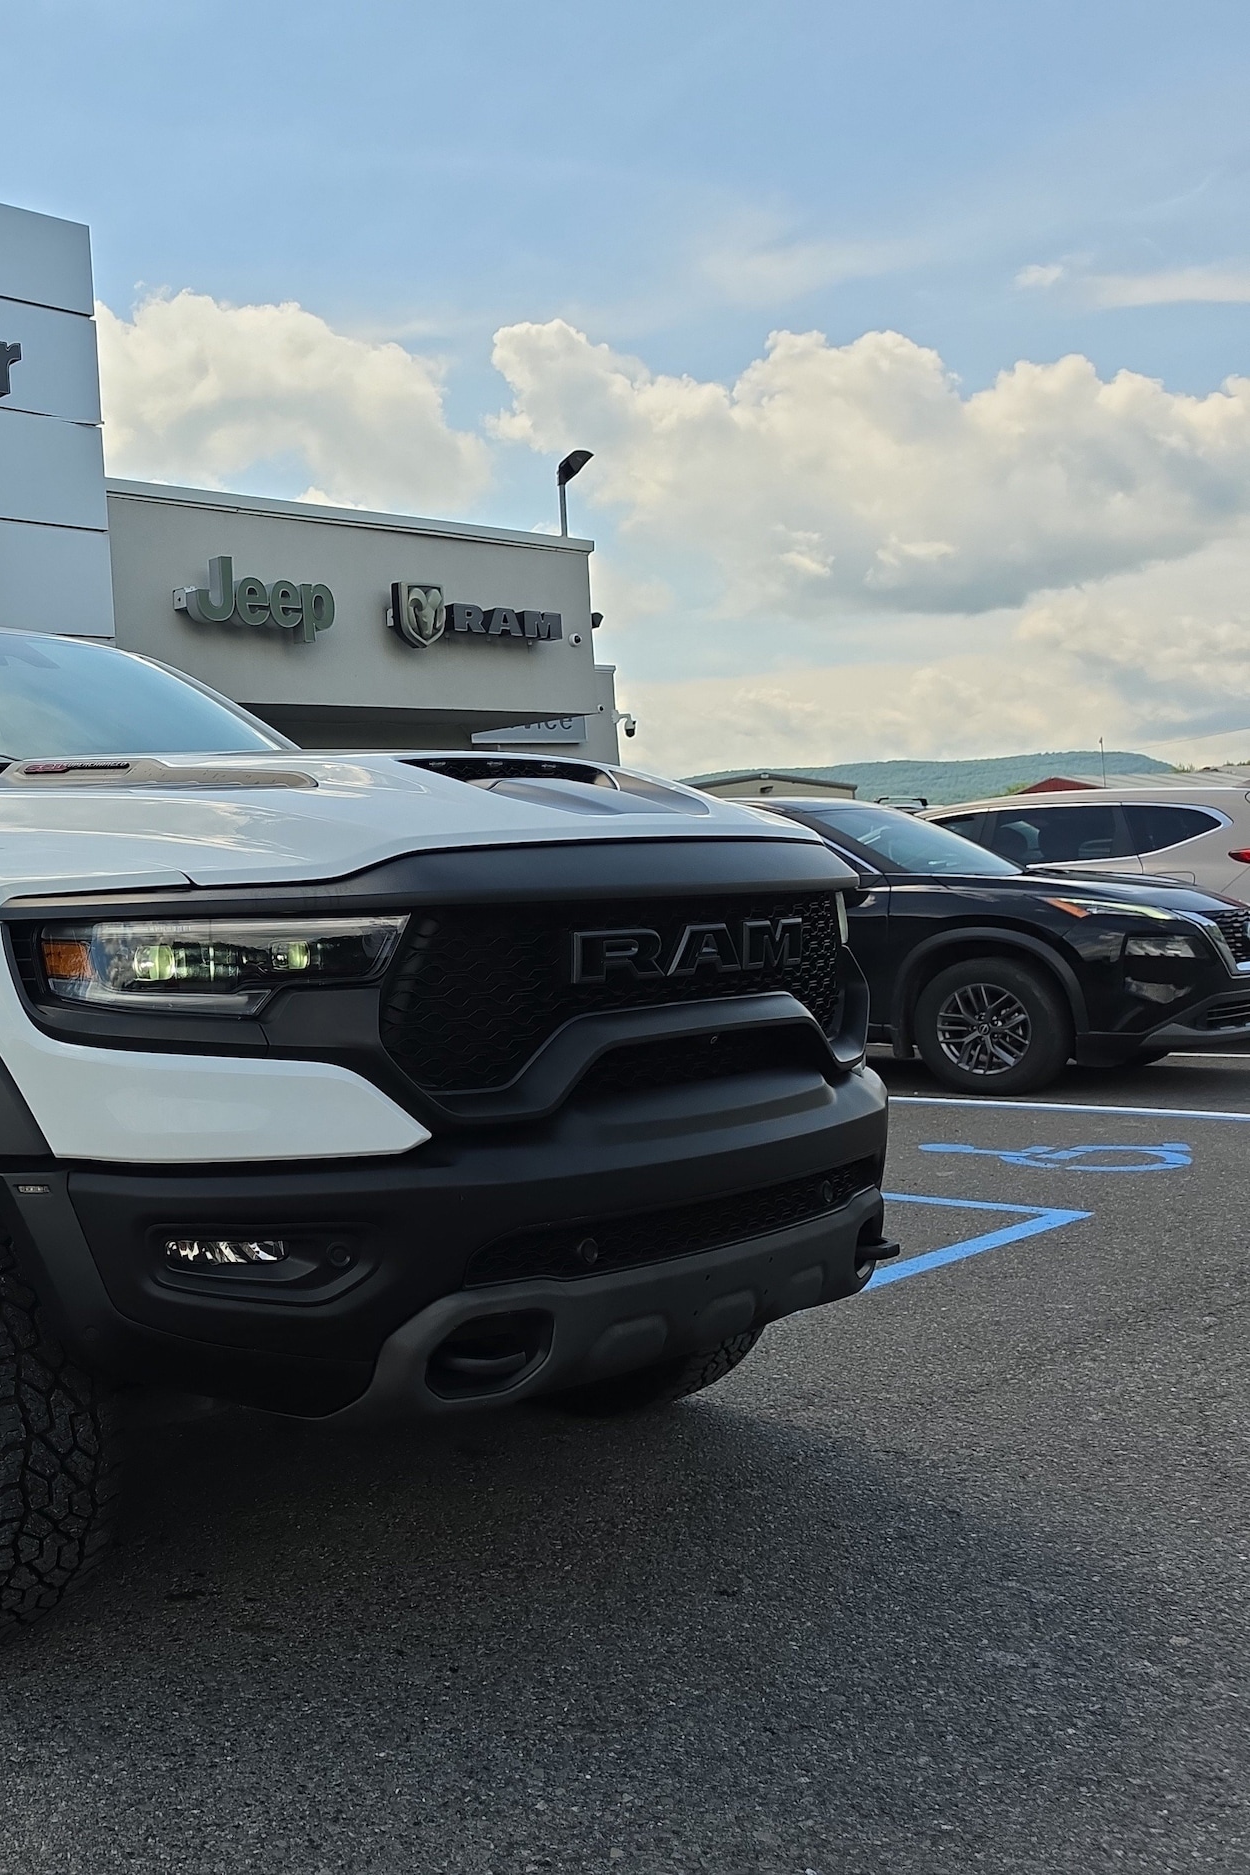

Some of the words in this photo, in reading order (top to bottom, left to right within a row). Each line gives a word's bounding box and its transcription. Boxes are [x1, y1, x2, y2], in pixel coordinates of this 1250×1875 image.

[186, 555, 335, 643] Jeep
[446, 602, 563, 641] RAM
[571, 917, 802, 984] RAM
